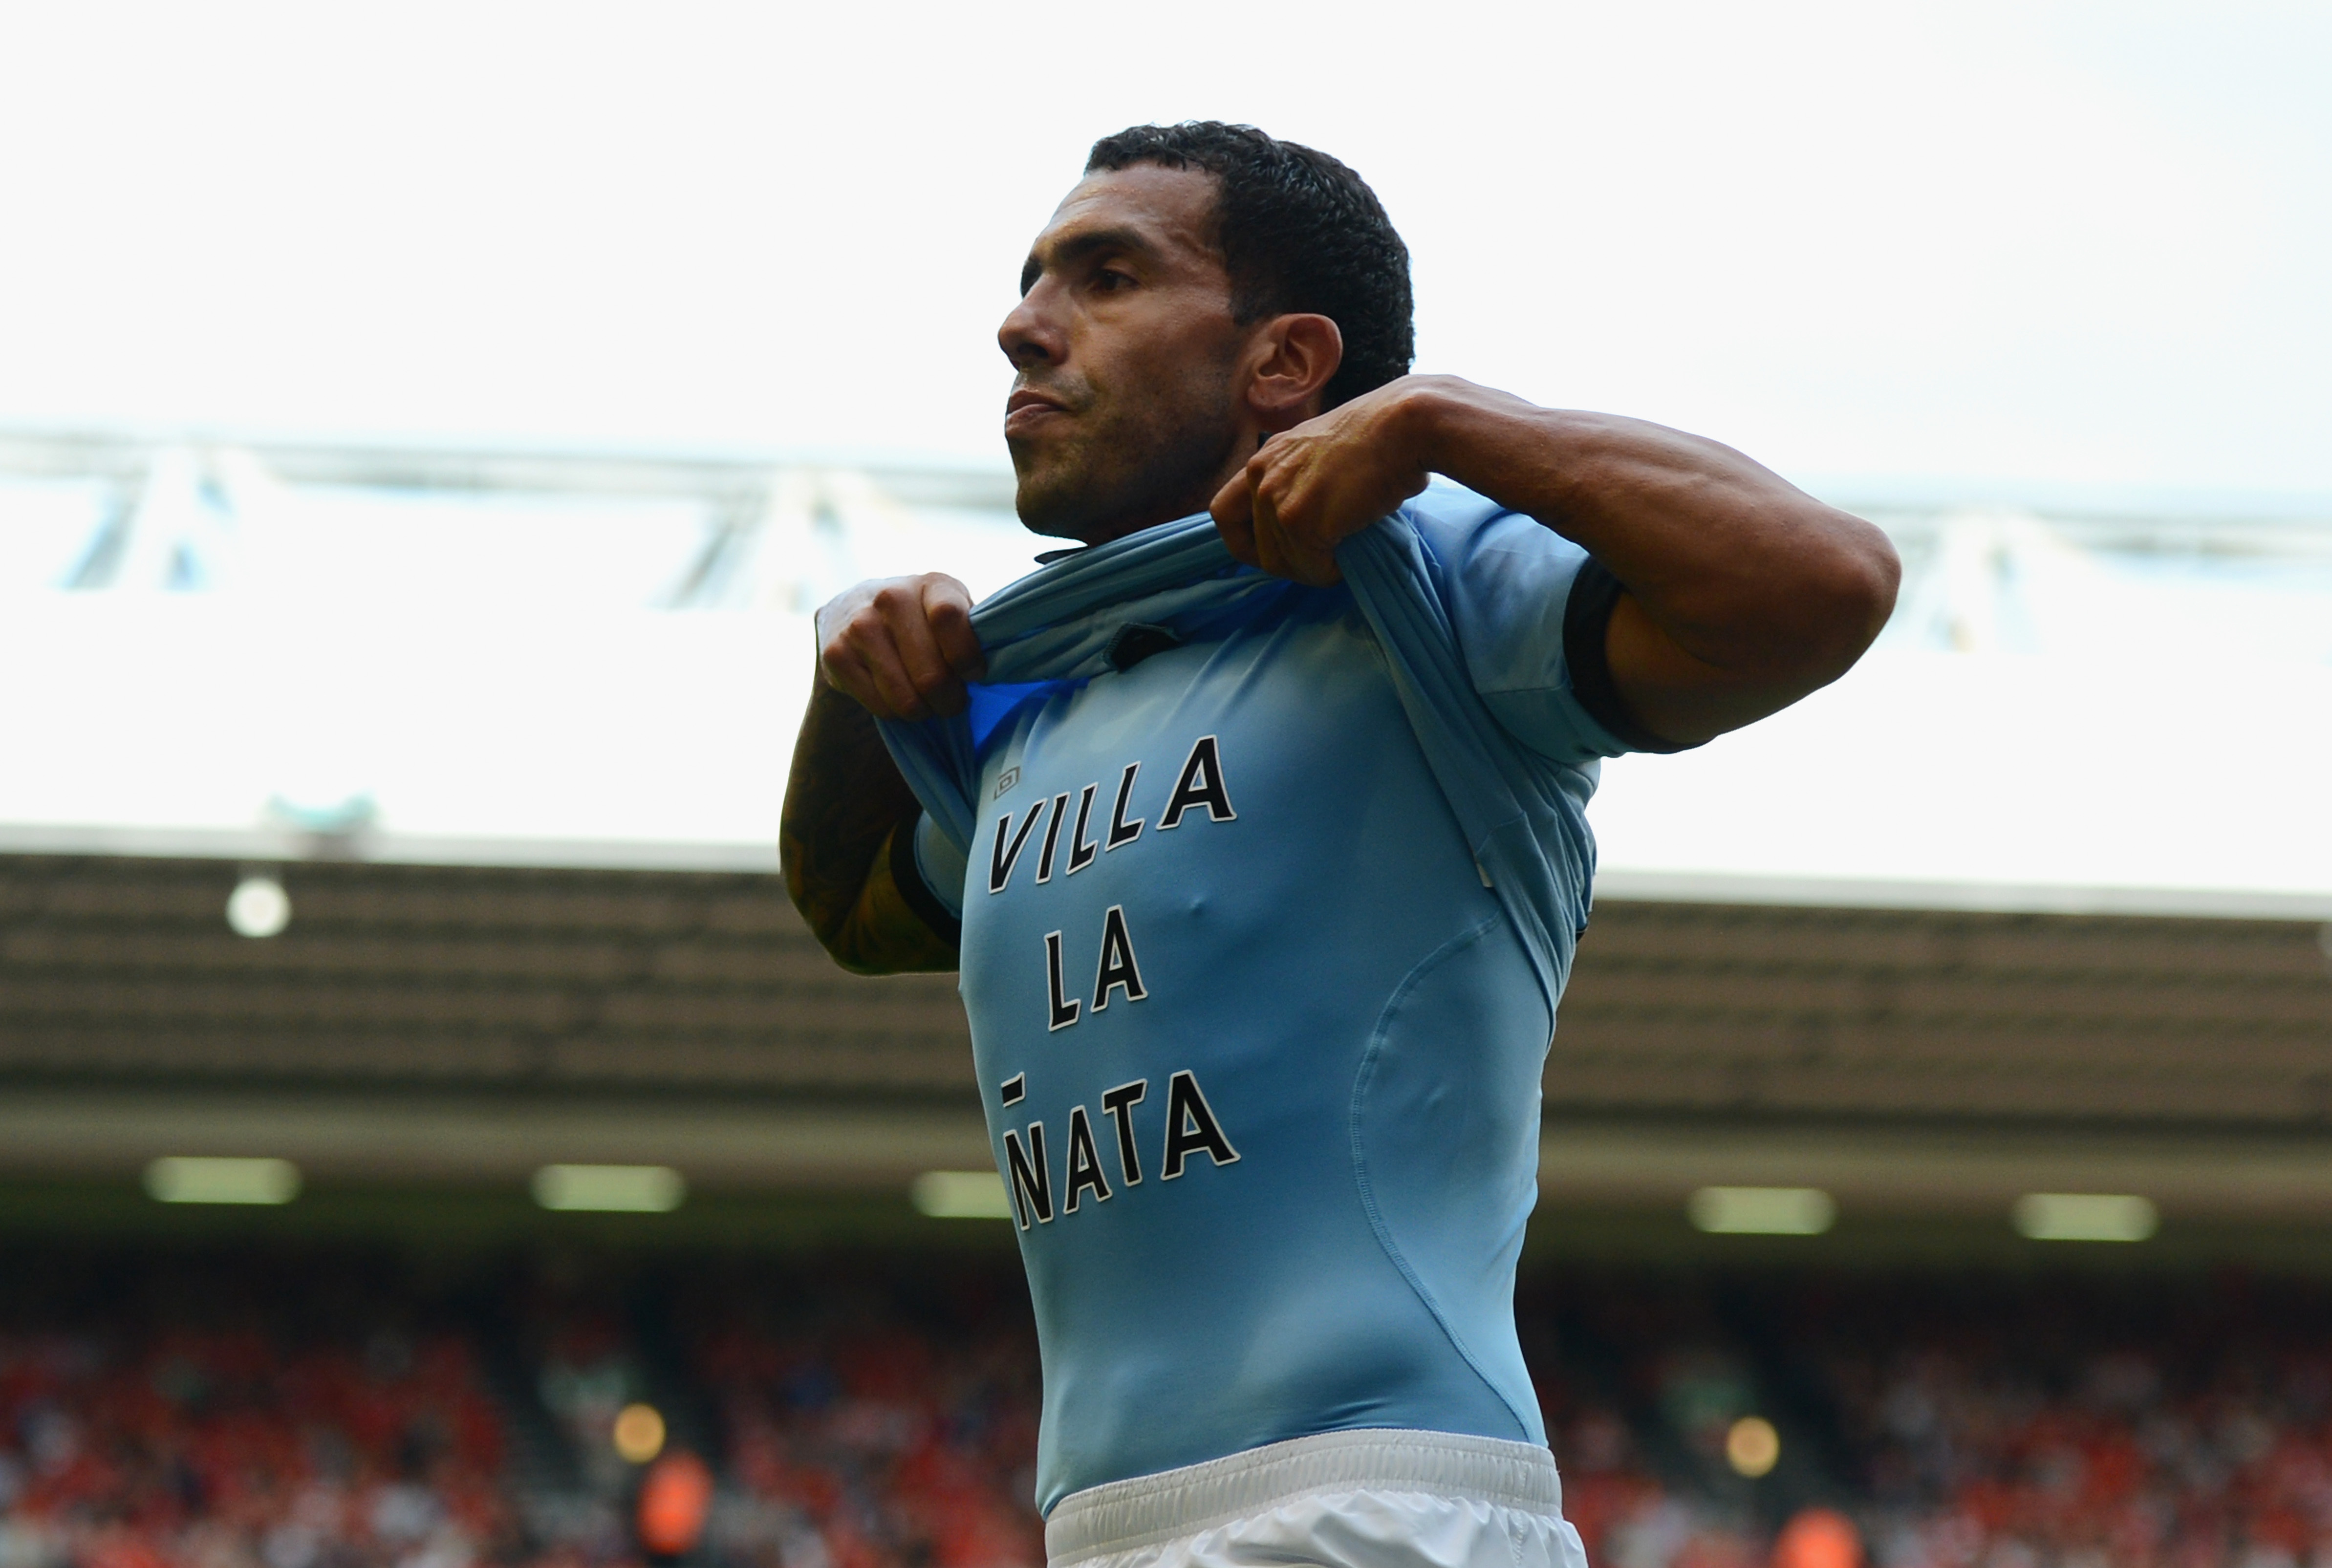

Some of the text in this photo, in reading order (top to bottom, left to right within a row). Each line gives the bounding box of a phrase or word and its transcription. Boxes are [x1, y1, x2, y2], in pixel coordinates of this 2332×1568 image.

[989, 734, 1237, 895] VILLA
[1044, 904, 1148, 1031] LA
[1001, 1070, 1241, 1230] ÑATA
